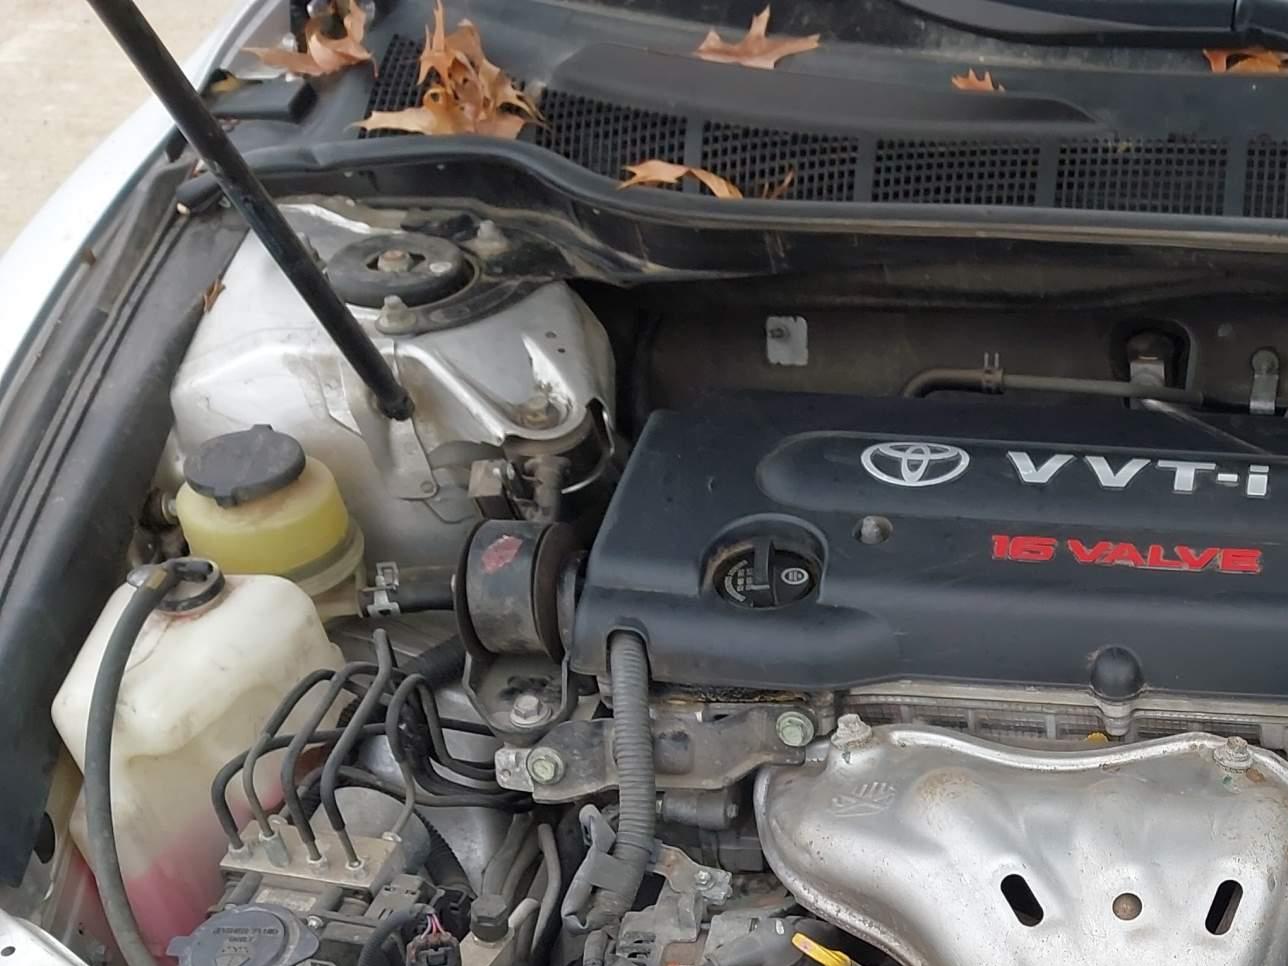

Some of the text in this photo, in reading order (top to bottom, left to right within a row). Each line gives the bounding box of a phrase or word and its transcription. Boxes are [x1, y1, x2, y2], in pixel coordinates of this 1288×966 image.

[1007, 451, 1270, 496] VVT-i
[993, 535, 1262, 573] 16 VALVE
